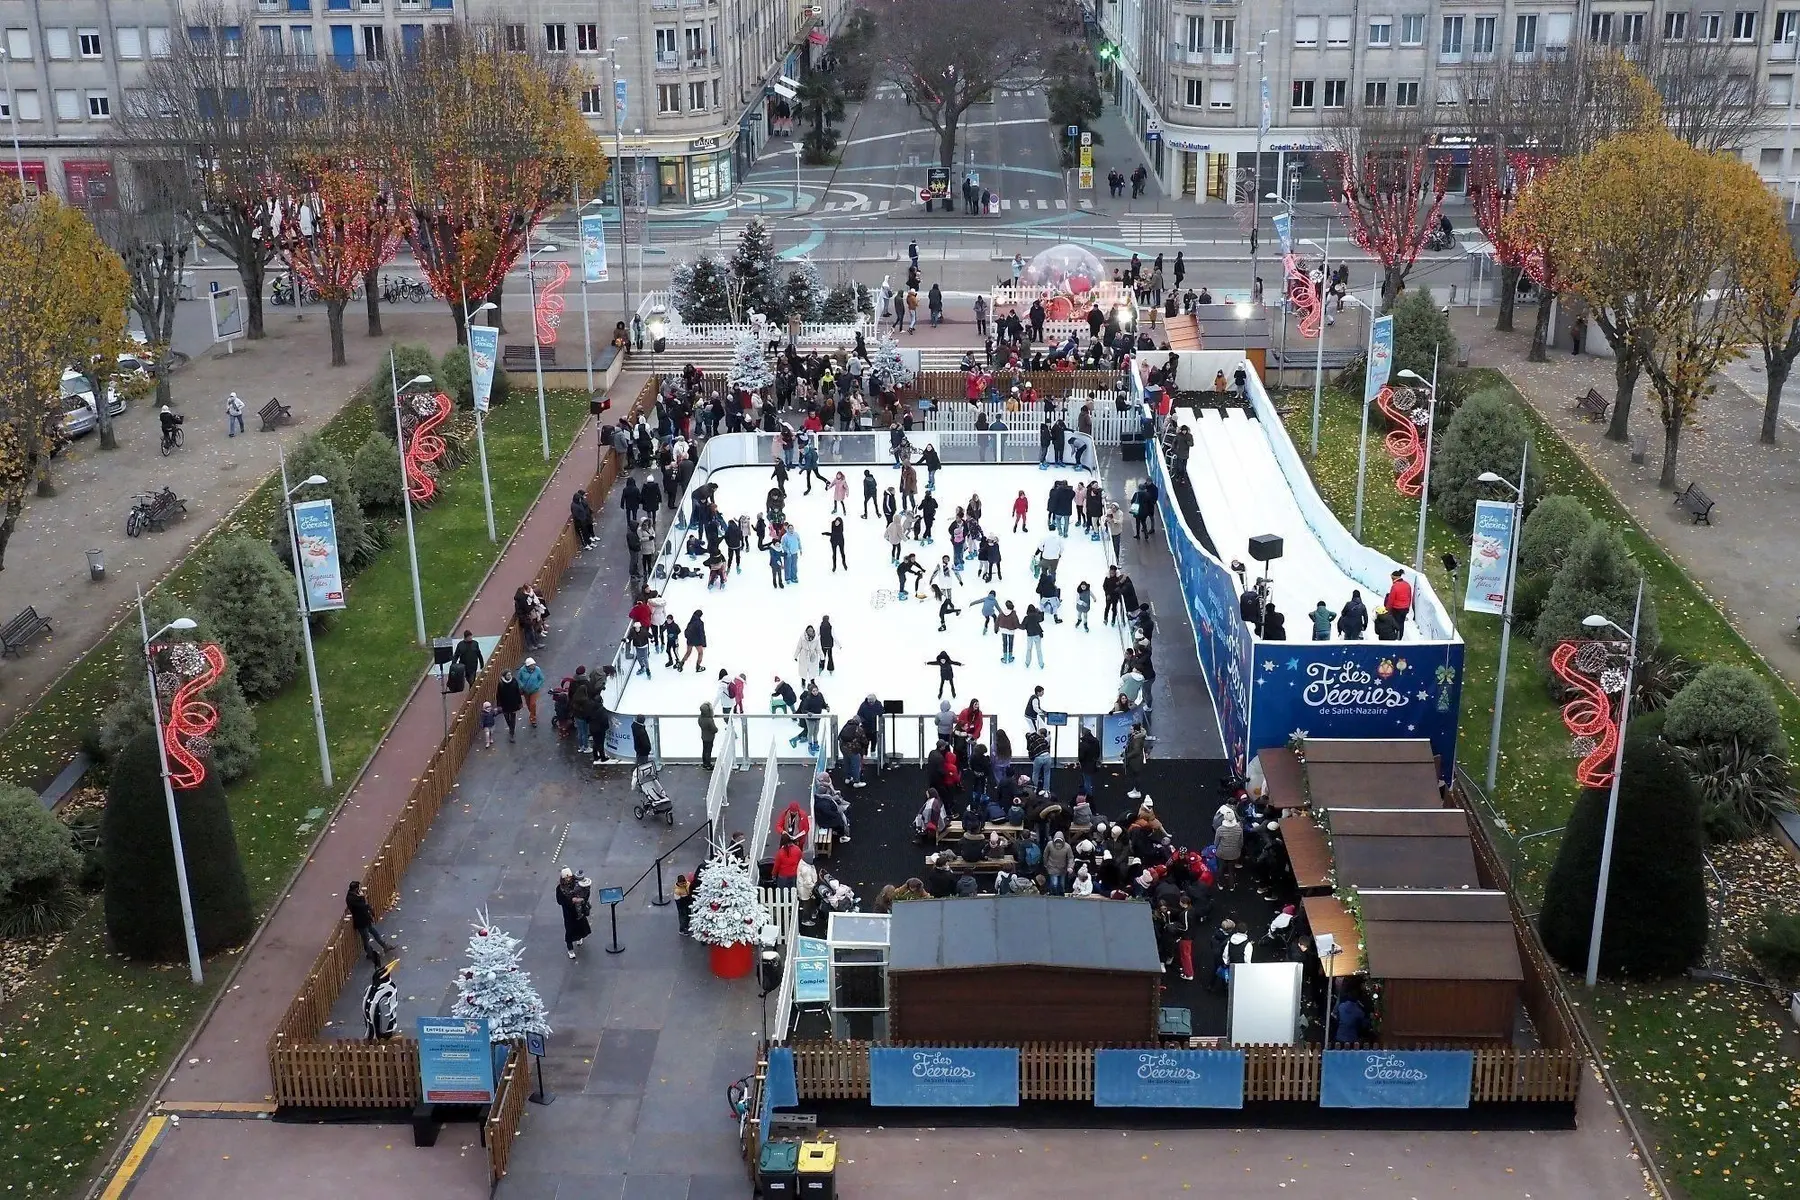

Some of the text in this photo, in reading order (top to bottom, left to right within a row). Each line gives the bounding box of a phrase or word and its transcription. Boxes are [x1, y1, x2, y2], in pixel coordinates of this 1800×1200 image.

[1303, 662, 1409, 707] Féeries
[1320, 707, 1388, 715] de Saint-Nazaire
[912, 1052, 976, 1079] Féeries
[1137, 1054, 1201, 1081] Féeries
[1364, 1055, 1428, 1081] Féeries
